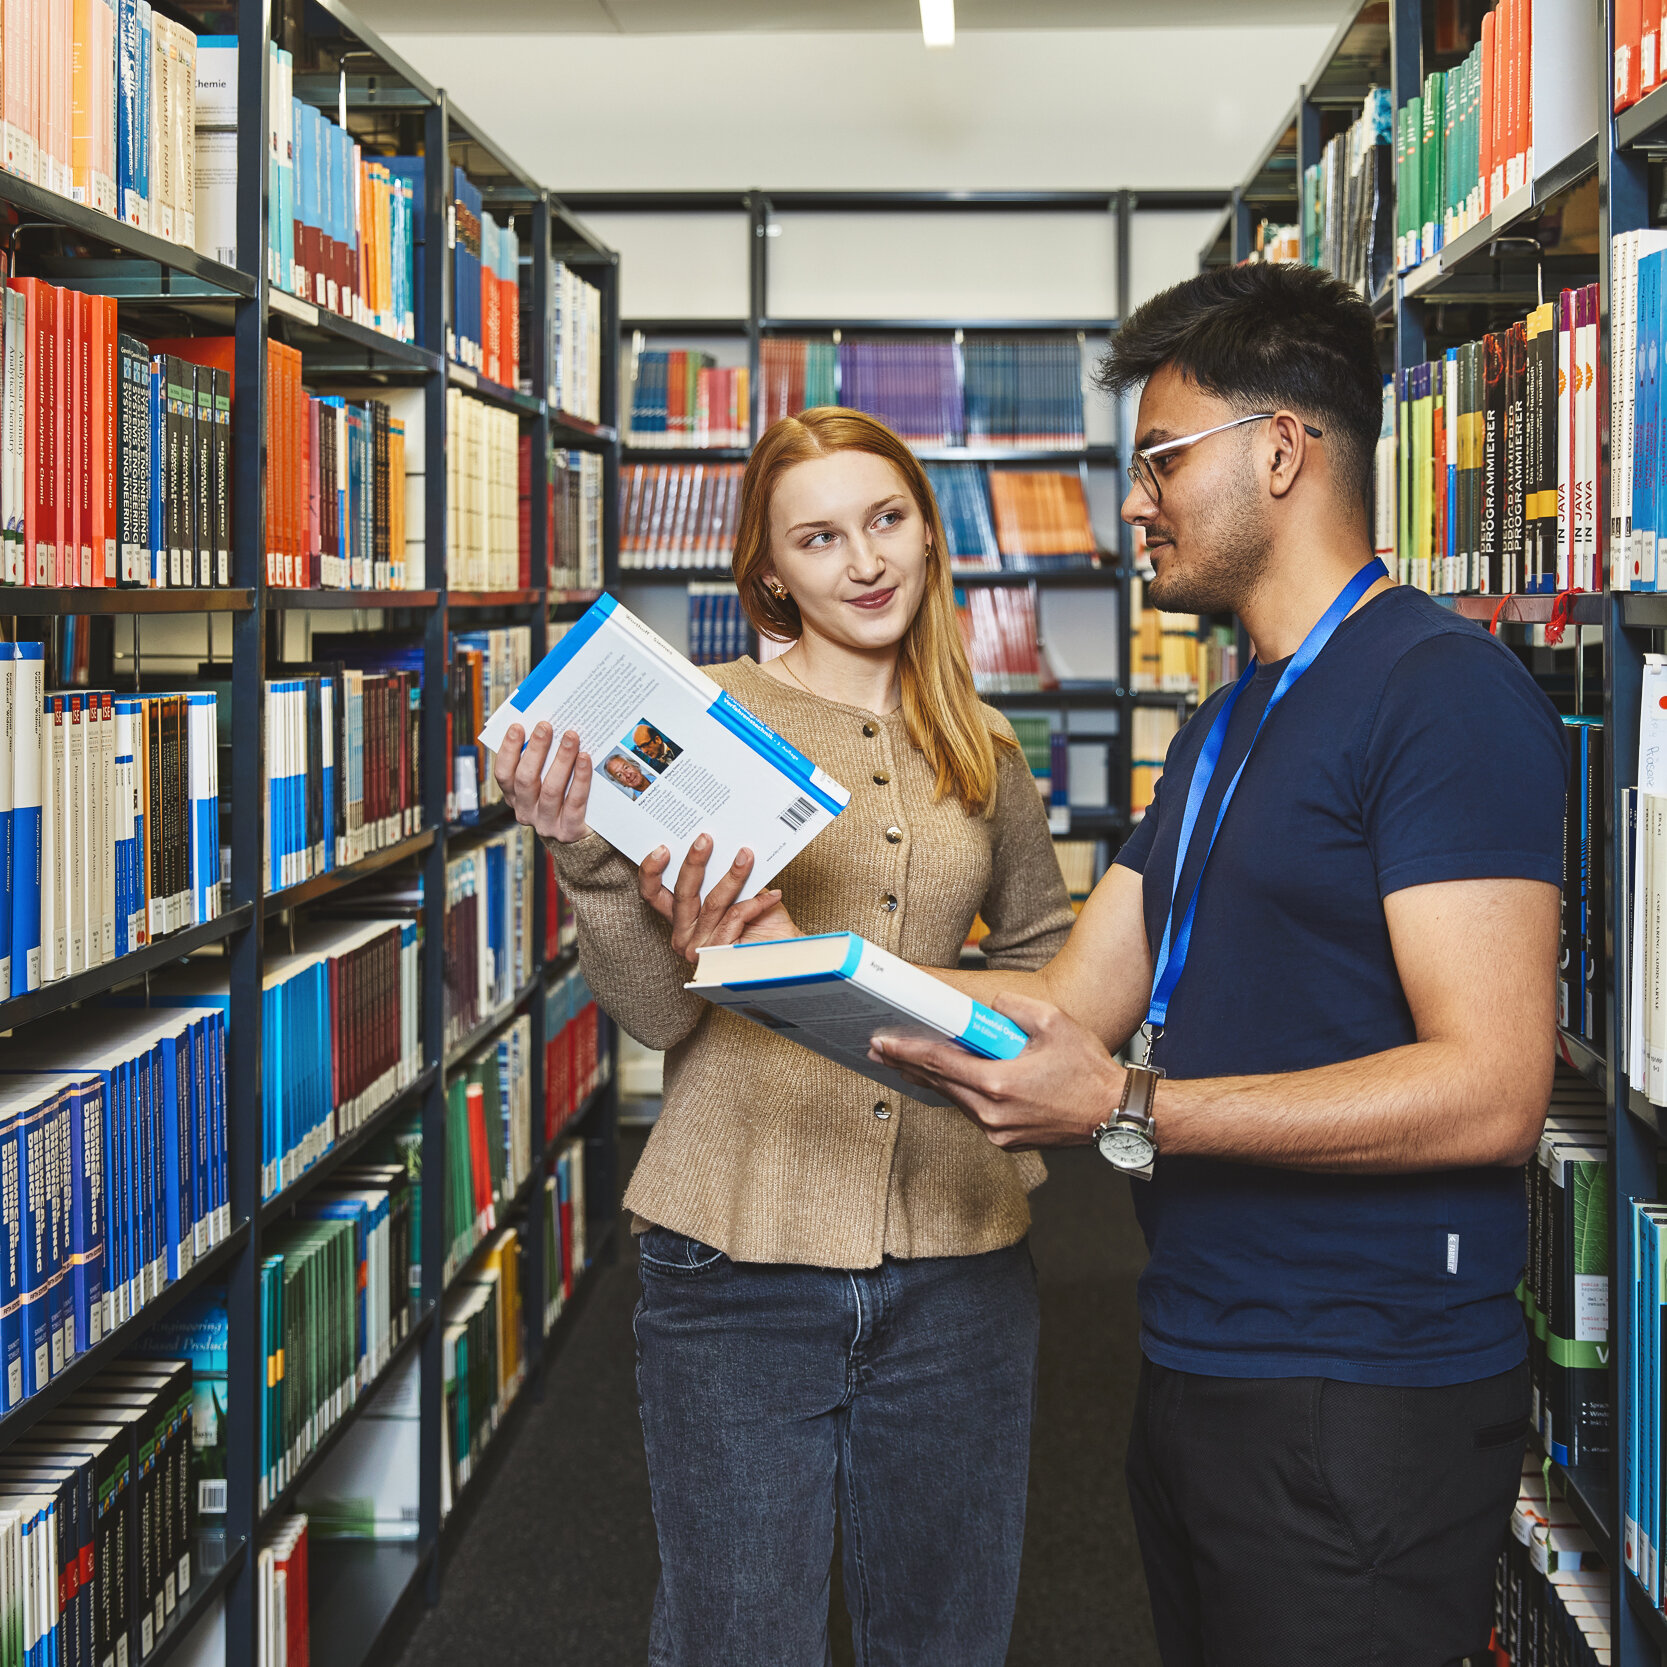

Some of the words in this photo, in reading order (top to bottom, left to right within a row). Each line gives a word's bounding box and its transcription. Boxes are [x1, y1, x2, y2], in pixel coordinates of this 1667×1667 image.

[128, 12, 136, 55] Solar
[128, 59, 136, 98] Cells
[1629, 320, 1637, 393] Freshwater
[1486, 410, 1495, 553] PROGRAMMIERER
[1515, 400, 1523, 550] PROGRAMMIERER
[1557, 483, 1565, 522] JAVA
[1557, 529, 1565, 543] IN
[1575, 527, 1582, 543] IN
[1585, 527, 1592, 543] IN
[72, 709, 80, 722] ISE
[102, 706, 111, 718] ISE
[723, 697, 774, 741] Verfahrenstechnik
[975, 1011, 1002, 1030] Industrial
[62, 1110, 70, 1248] ENGINEERING
[90, 1100, 98, 1235] ENGINEERING
[33, 1130, 42, 1273] ENGINEERING
[50, 1120, 59, 1261] ENGINEERING
[7, 1141, 16, 1287] ENGINEERING
